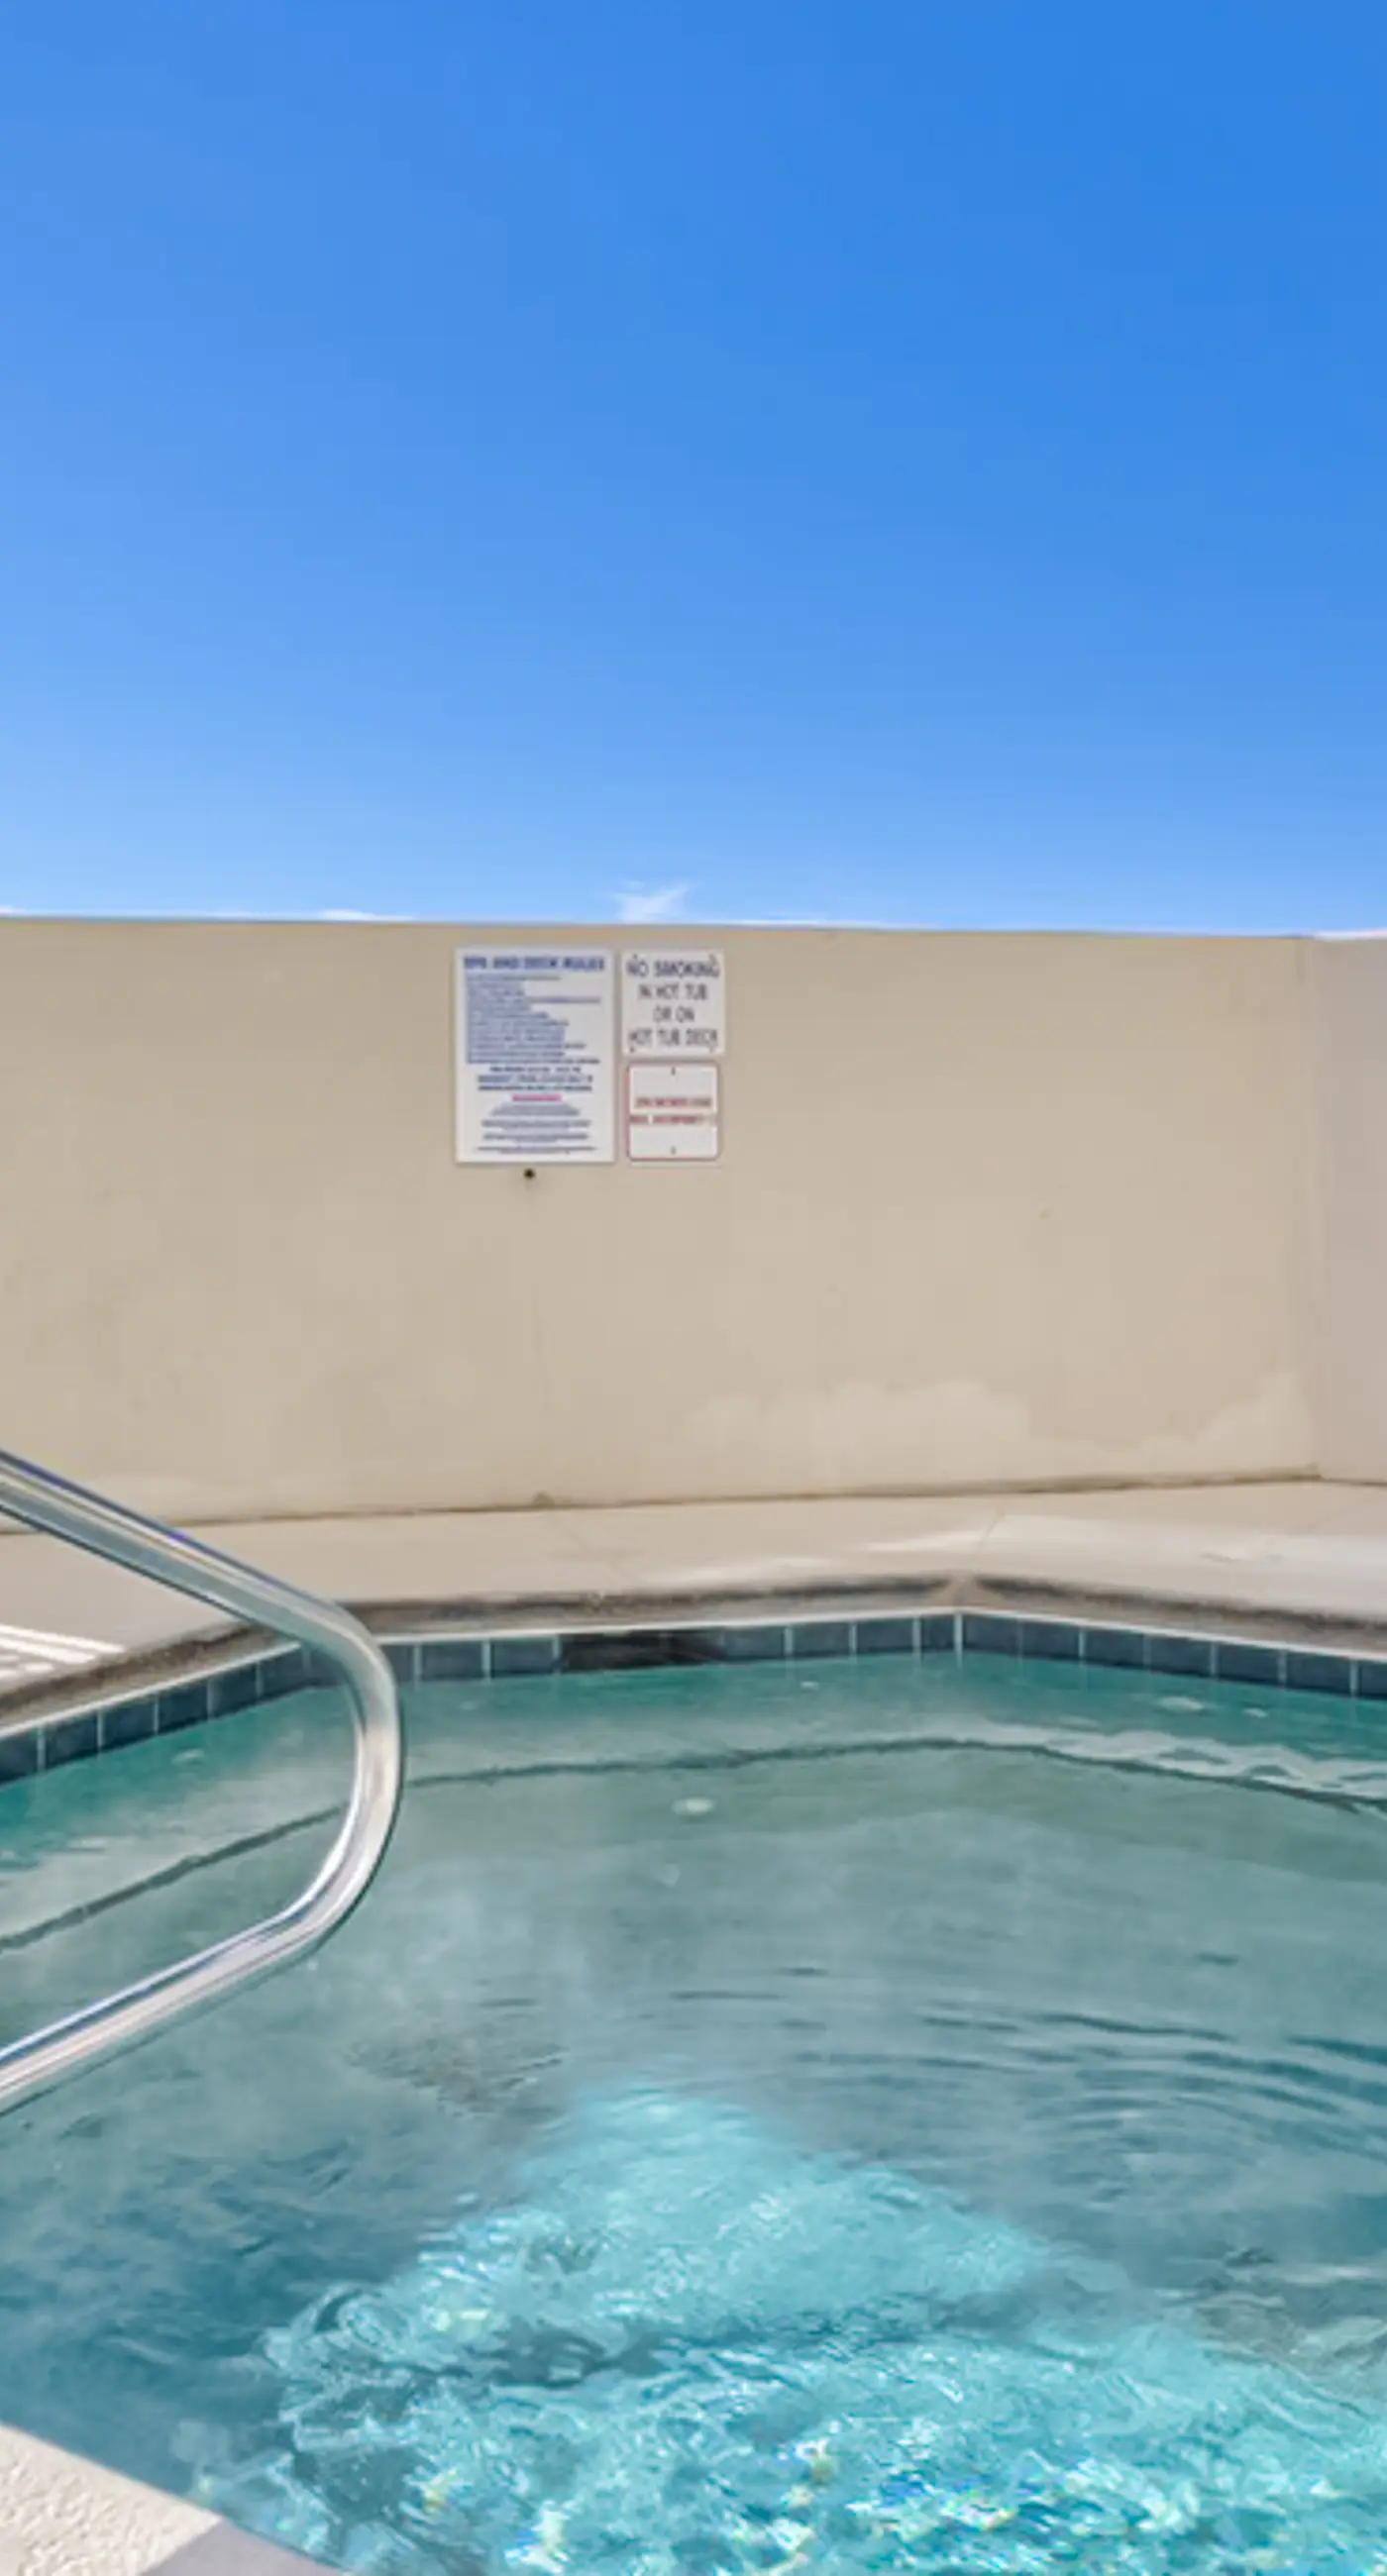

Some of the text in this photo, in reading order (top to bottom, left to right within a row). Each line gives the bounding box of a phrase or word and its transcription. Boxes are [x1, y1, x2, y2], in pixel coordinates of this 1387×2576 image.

[626, 959, 720, 979] NO SMOKING
[637, 982, 708, 1001] IN HOT TUB
[653, 1004, 695, 1023] OR ON
[628, 1027, 653, 1046] HOT
[657, 1027, 681, 1046] TUB
